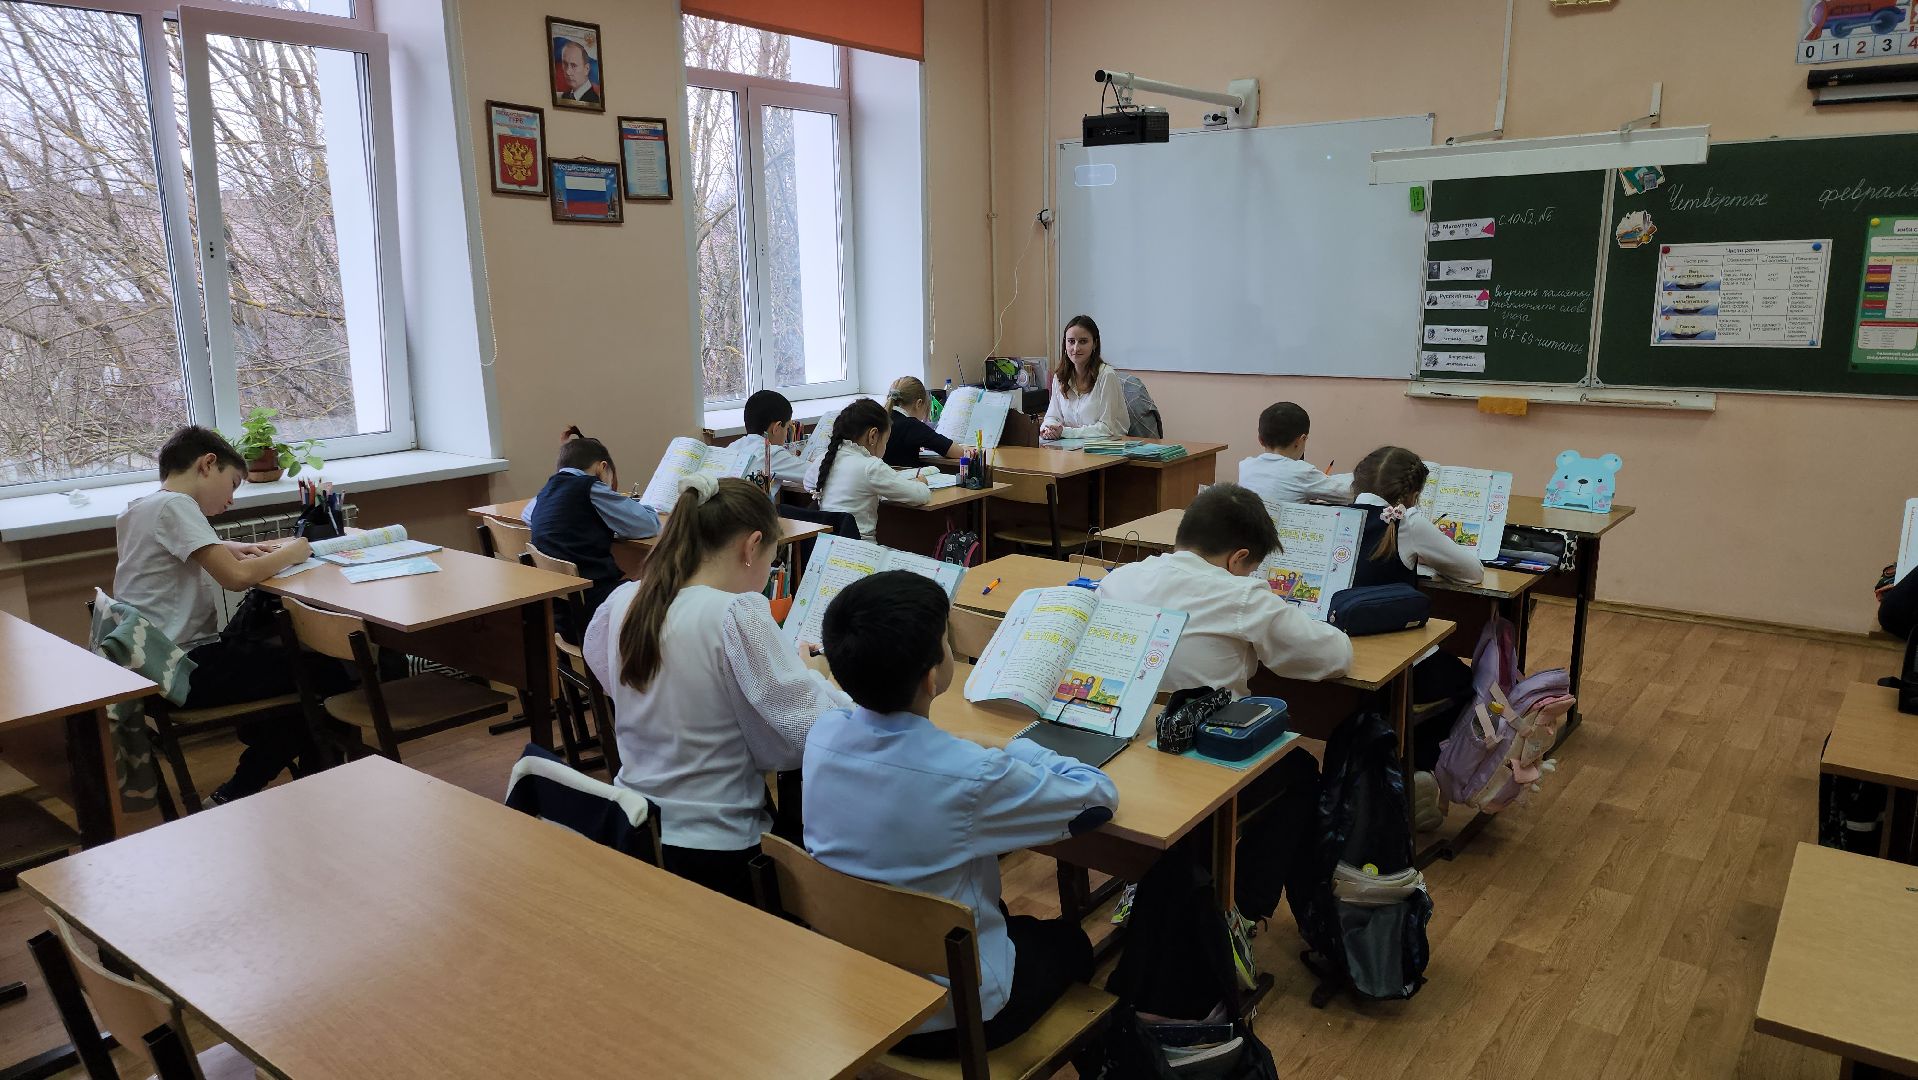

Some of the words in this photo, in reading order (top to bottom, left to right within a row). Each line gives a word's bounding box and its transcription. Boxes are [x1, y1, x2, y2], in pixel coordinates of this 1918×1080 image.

[1805, 45, 1815, 58] 0
[1832, 43, 1840, 56] 1
[1856, 40, 1867, 54] 2
[1882, 38, 1893, 52] 3
[1908, 36, 1918, 49] 4
